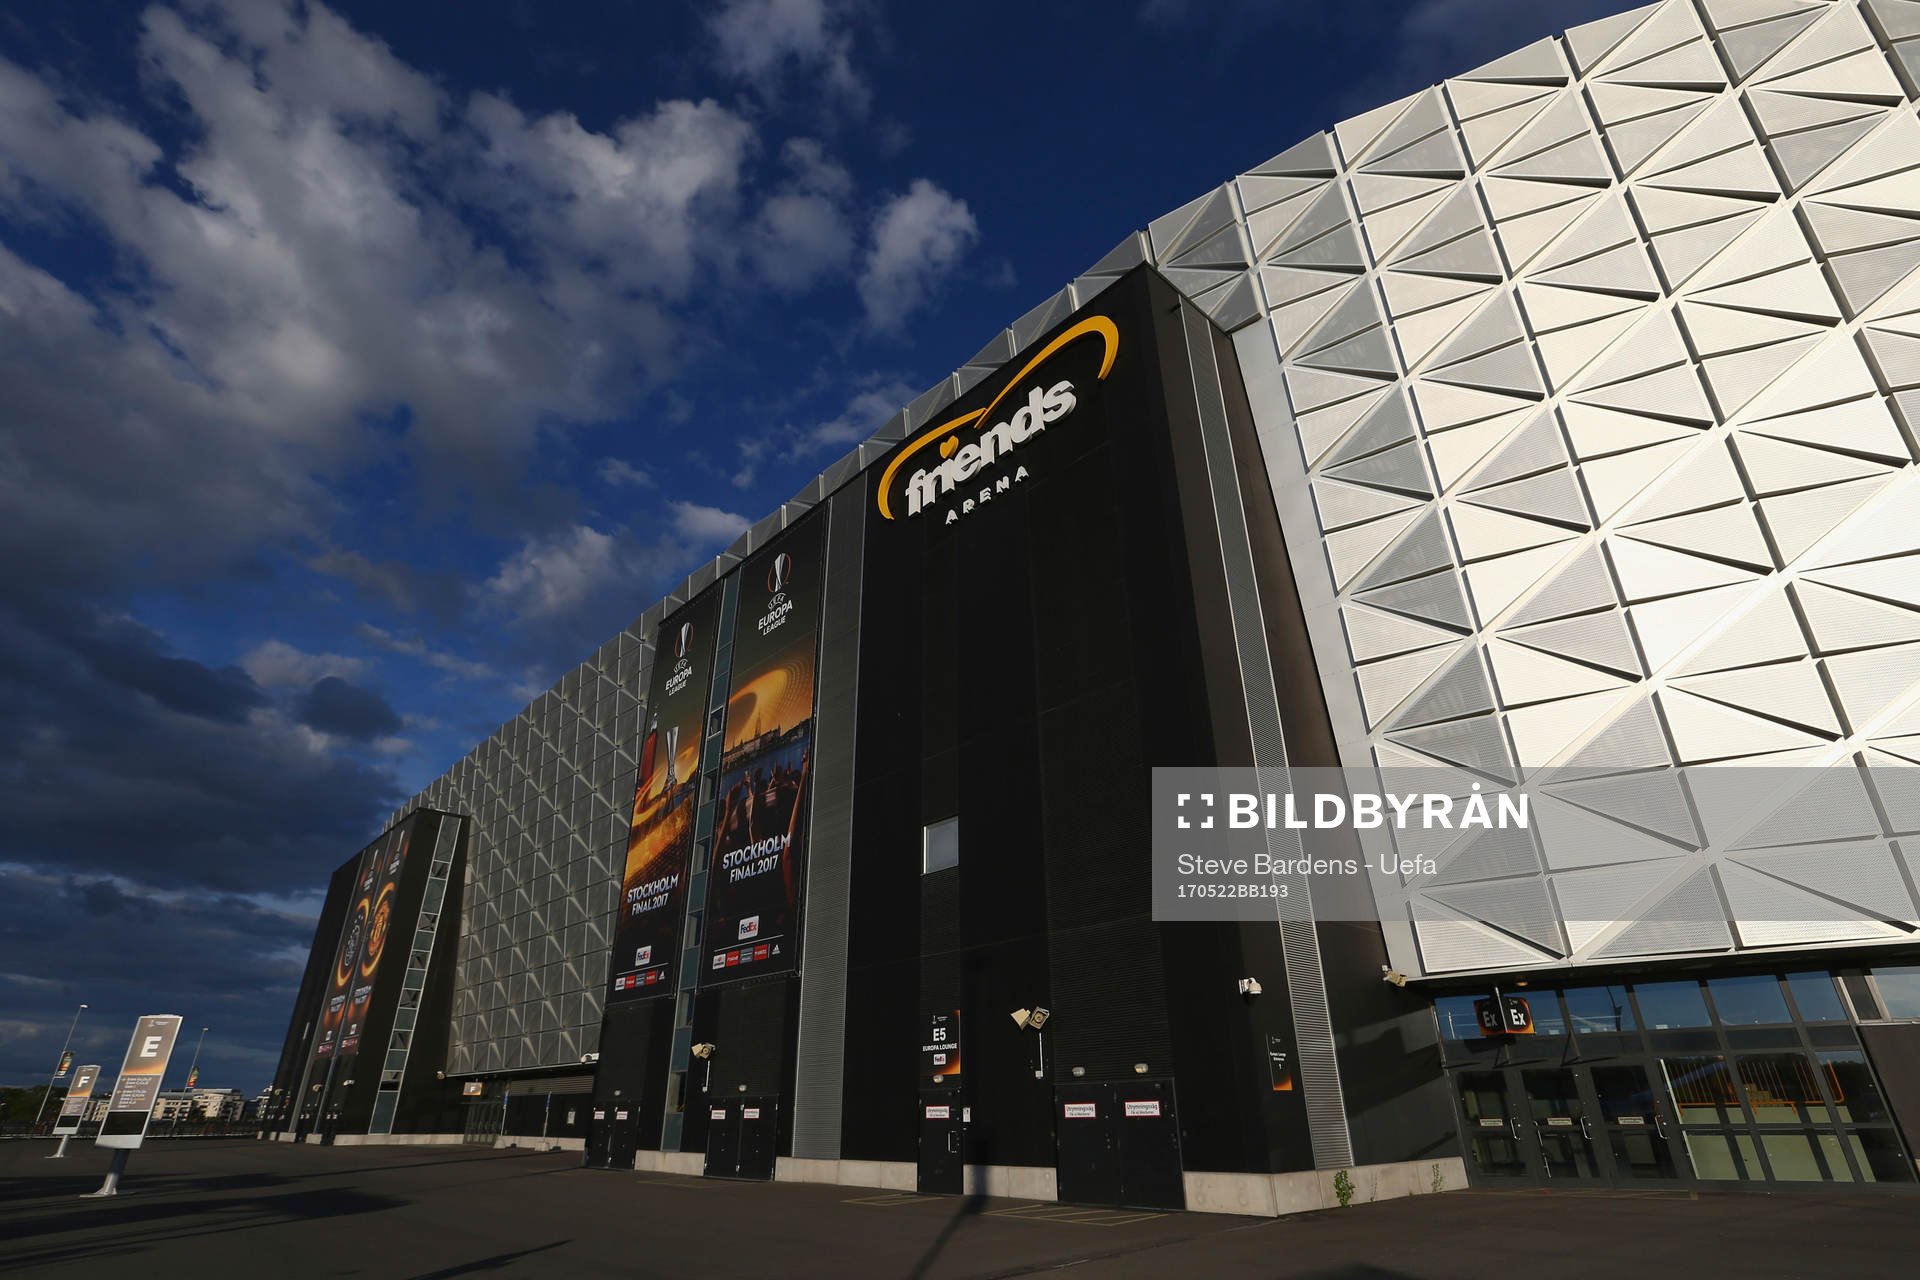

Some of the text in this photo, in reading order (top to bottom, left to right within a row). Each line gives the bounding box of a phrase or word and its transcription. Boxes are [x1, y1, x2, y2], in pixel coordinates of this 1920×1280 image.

[905, 380, 1077, 517] friends
[945, 465, 1030, 525] ARENA
[758, 600, 793, 630] EUROPA
[763, 615, 786, 636] LEAGUE
[665, 666, 692, 690] EUROPA
[722, 832, 791, 870] STOCKHOLM
[730, 854, 779, 884] FINAL 2017
[627, 872, 680, 904] STOCKHOLM
[632, 892, 669, 916] FINAL 2017
[740, 921, 758, 935] FedEx
[1482, 1010, 1498, 1028] Ex
[1510, 1008, 1526, 1026] Ex
[933, 1027, 946, 1042] E5
[140, 1035, 162, 1058] E
[922, 1042, 957, 1052] EUROPA LOUNGE
[78, 1075, 90, 1088] F
